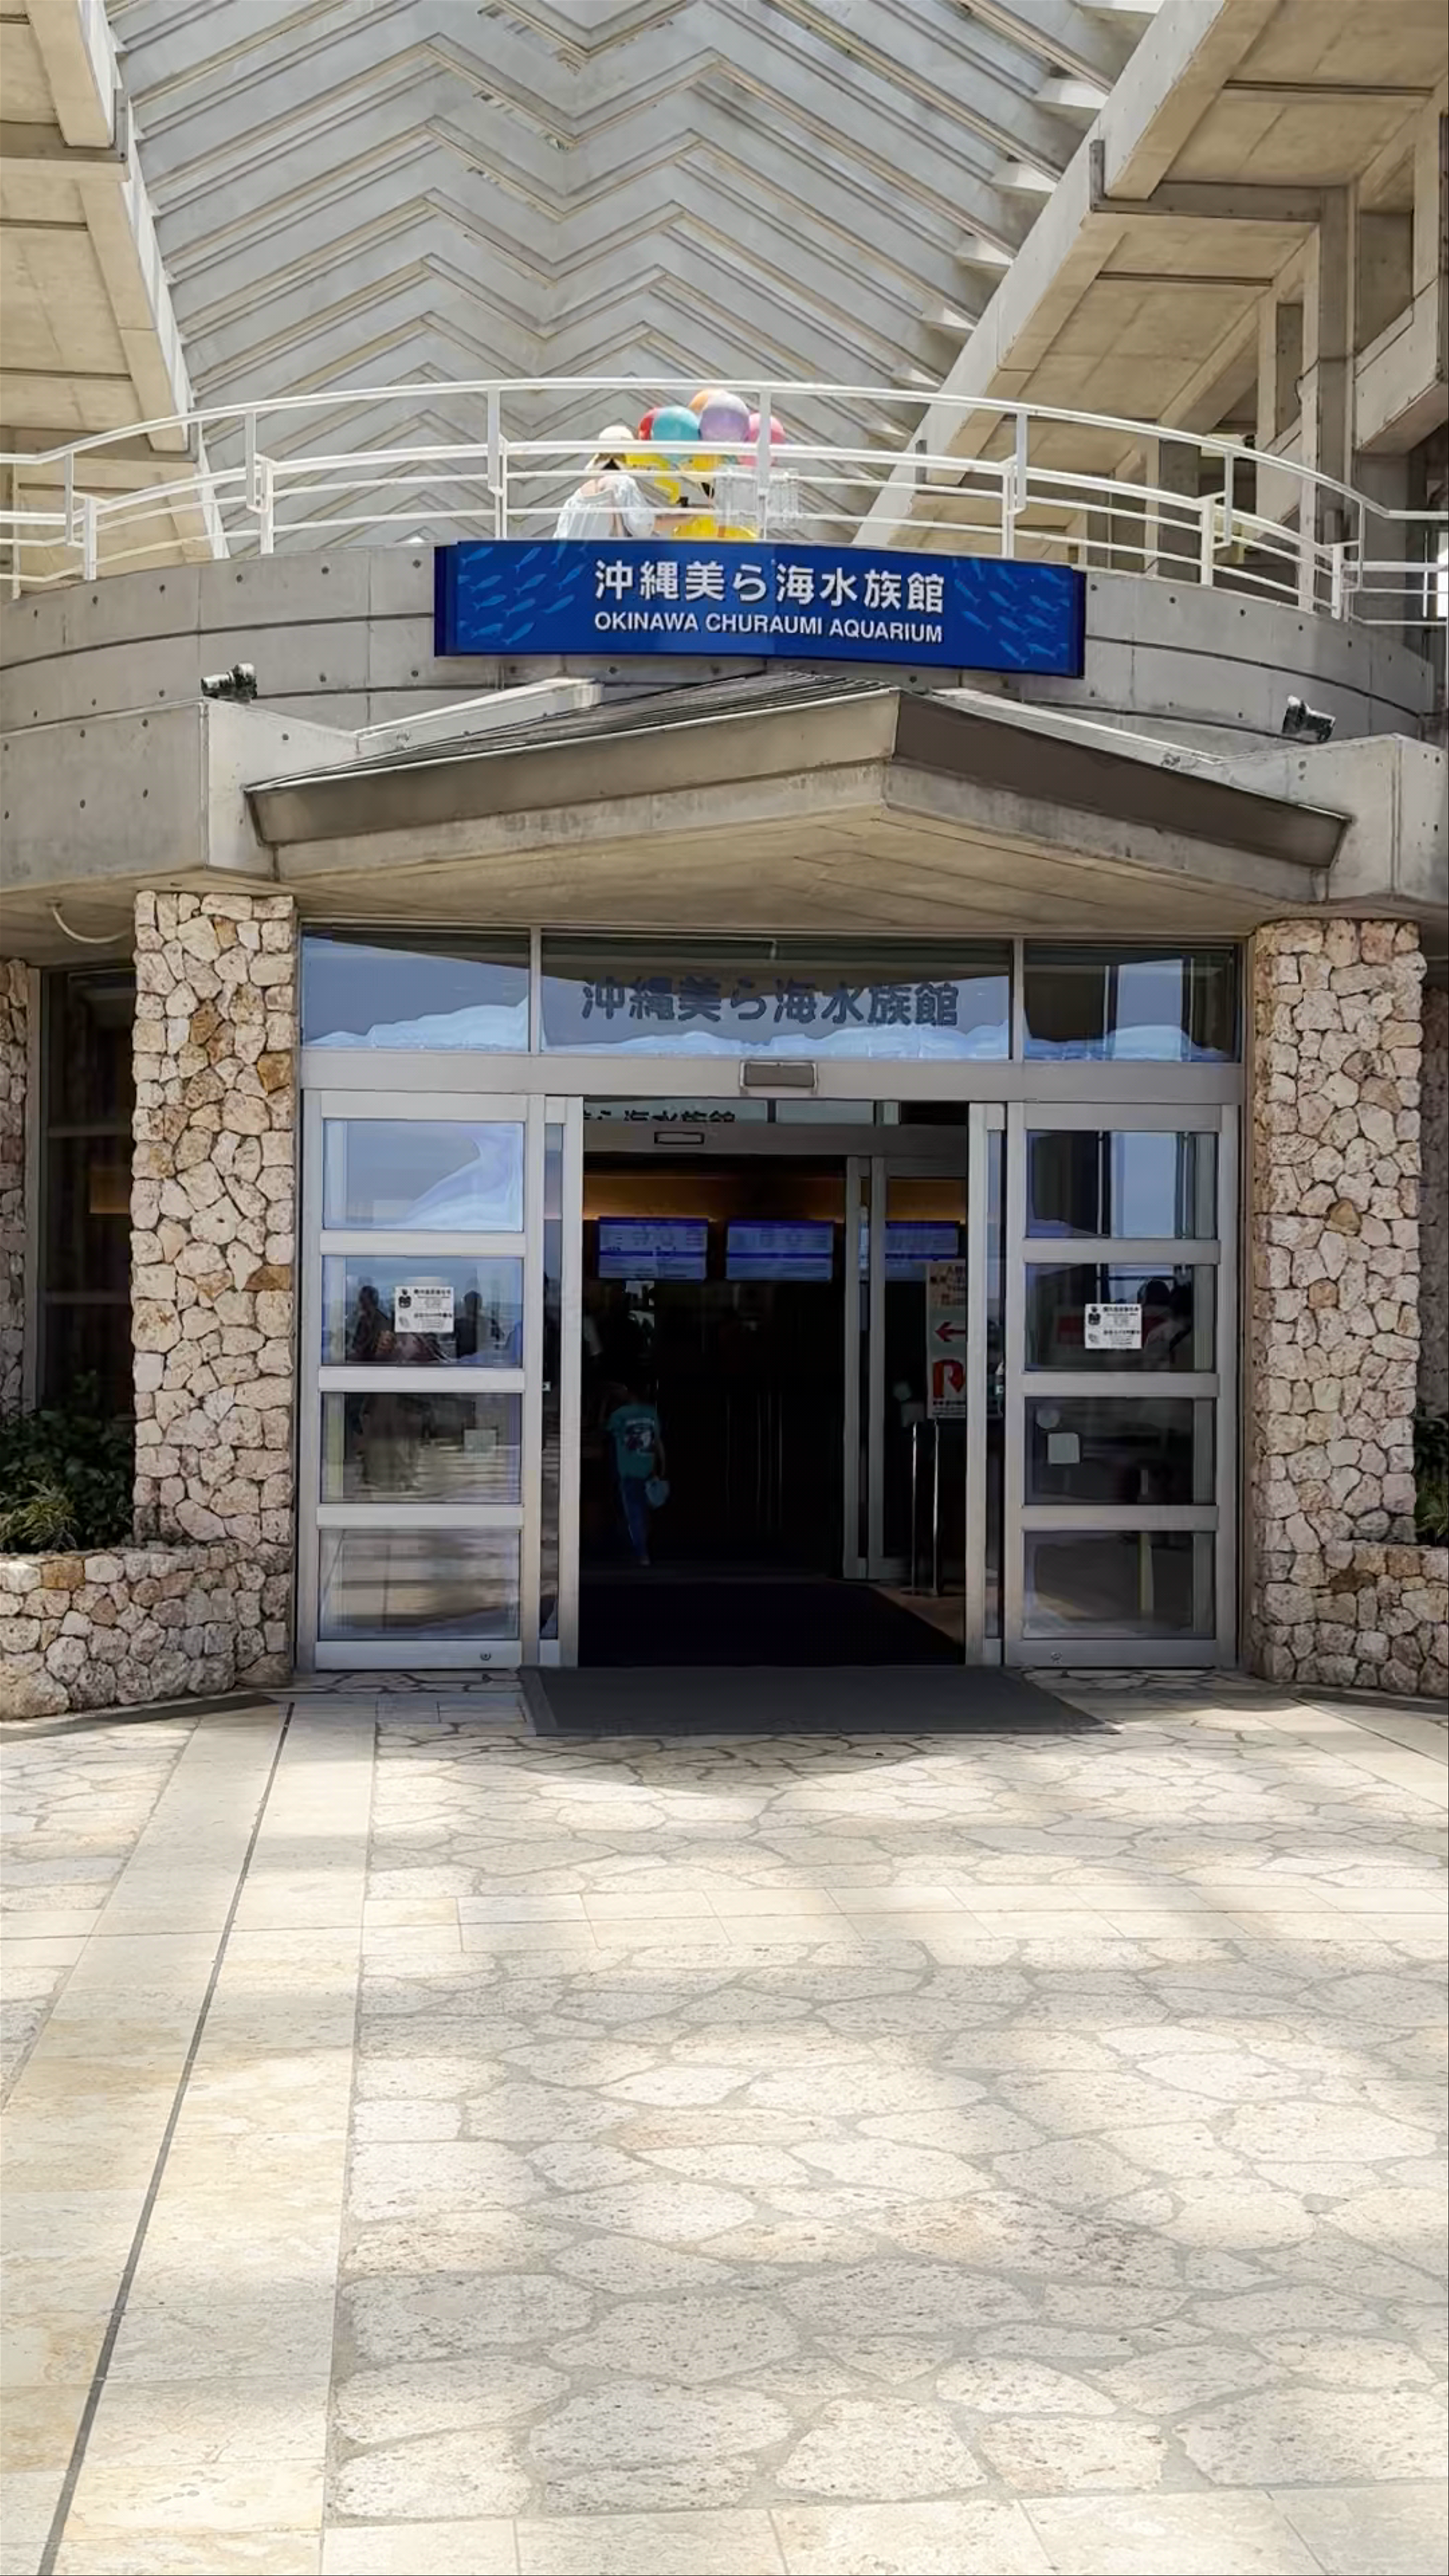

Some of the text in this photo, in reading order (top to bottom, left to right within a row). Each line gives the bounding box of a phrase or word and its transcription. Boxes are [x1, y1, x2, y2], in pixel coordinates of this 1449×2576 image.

[595, 560, 944, 613] 沖縄美ら海水族館
[594, 611, 943, 643] OKINAWA CHURAUMI AQUARIUM
[581, 975, 959, 1026] 沖縄美ら海水族館
